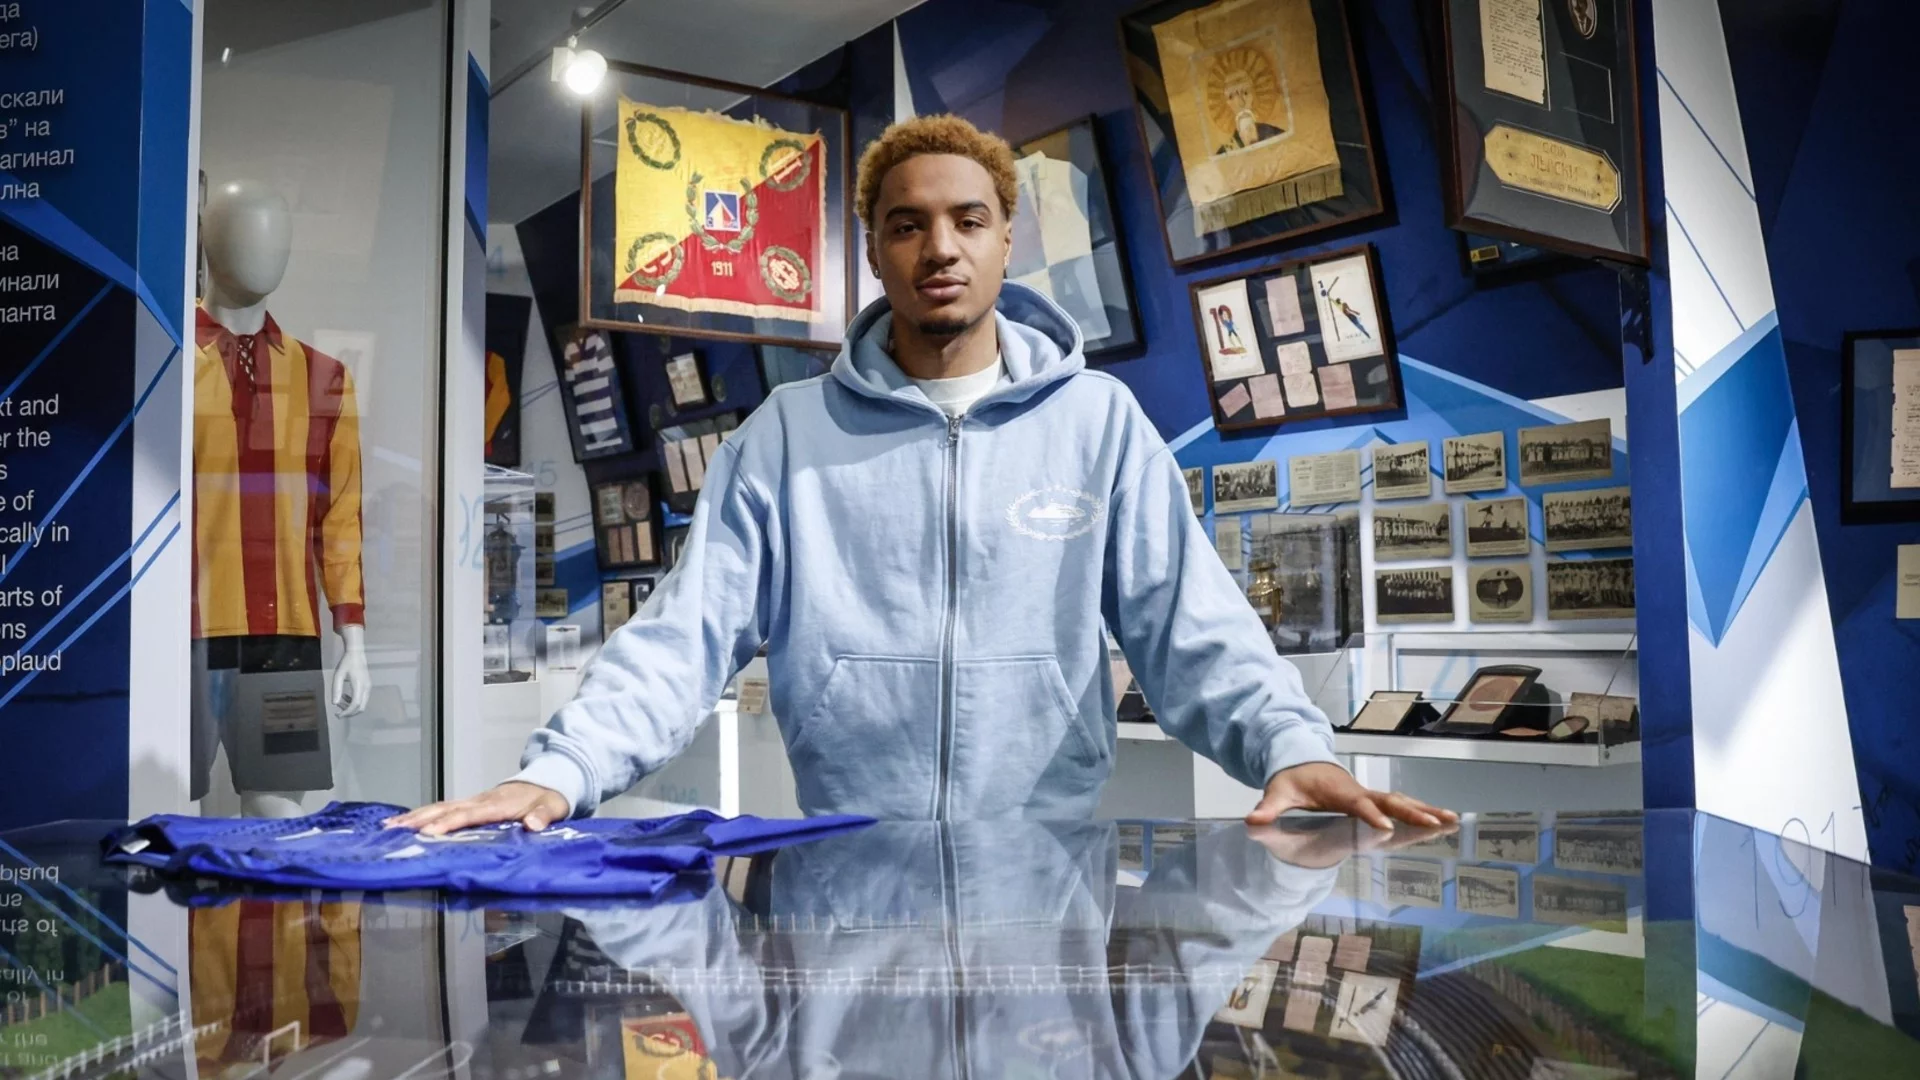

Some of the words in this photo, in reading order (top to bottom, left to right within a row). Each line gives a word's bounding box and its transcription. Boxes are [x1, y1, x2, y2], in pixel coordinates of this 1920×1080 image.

[0, 88, 63, 108] скали
[25, 119, 50, 136] на
[0, 147, 74, 169] агинал
[1, 181, 39, 199] лна
[711, 261, 733, 277] 1911
[19, 394, 59, 415] and
[17, 427, 50, 447] the
[12, 490, 34, 511] of
[52, 520, 69, 542] in
[41, 585, 63, 607] of
[0, 622, 26, 640] ns
[0, 650, 61, 676] plaud
